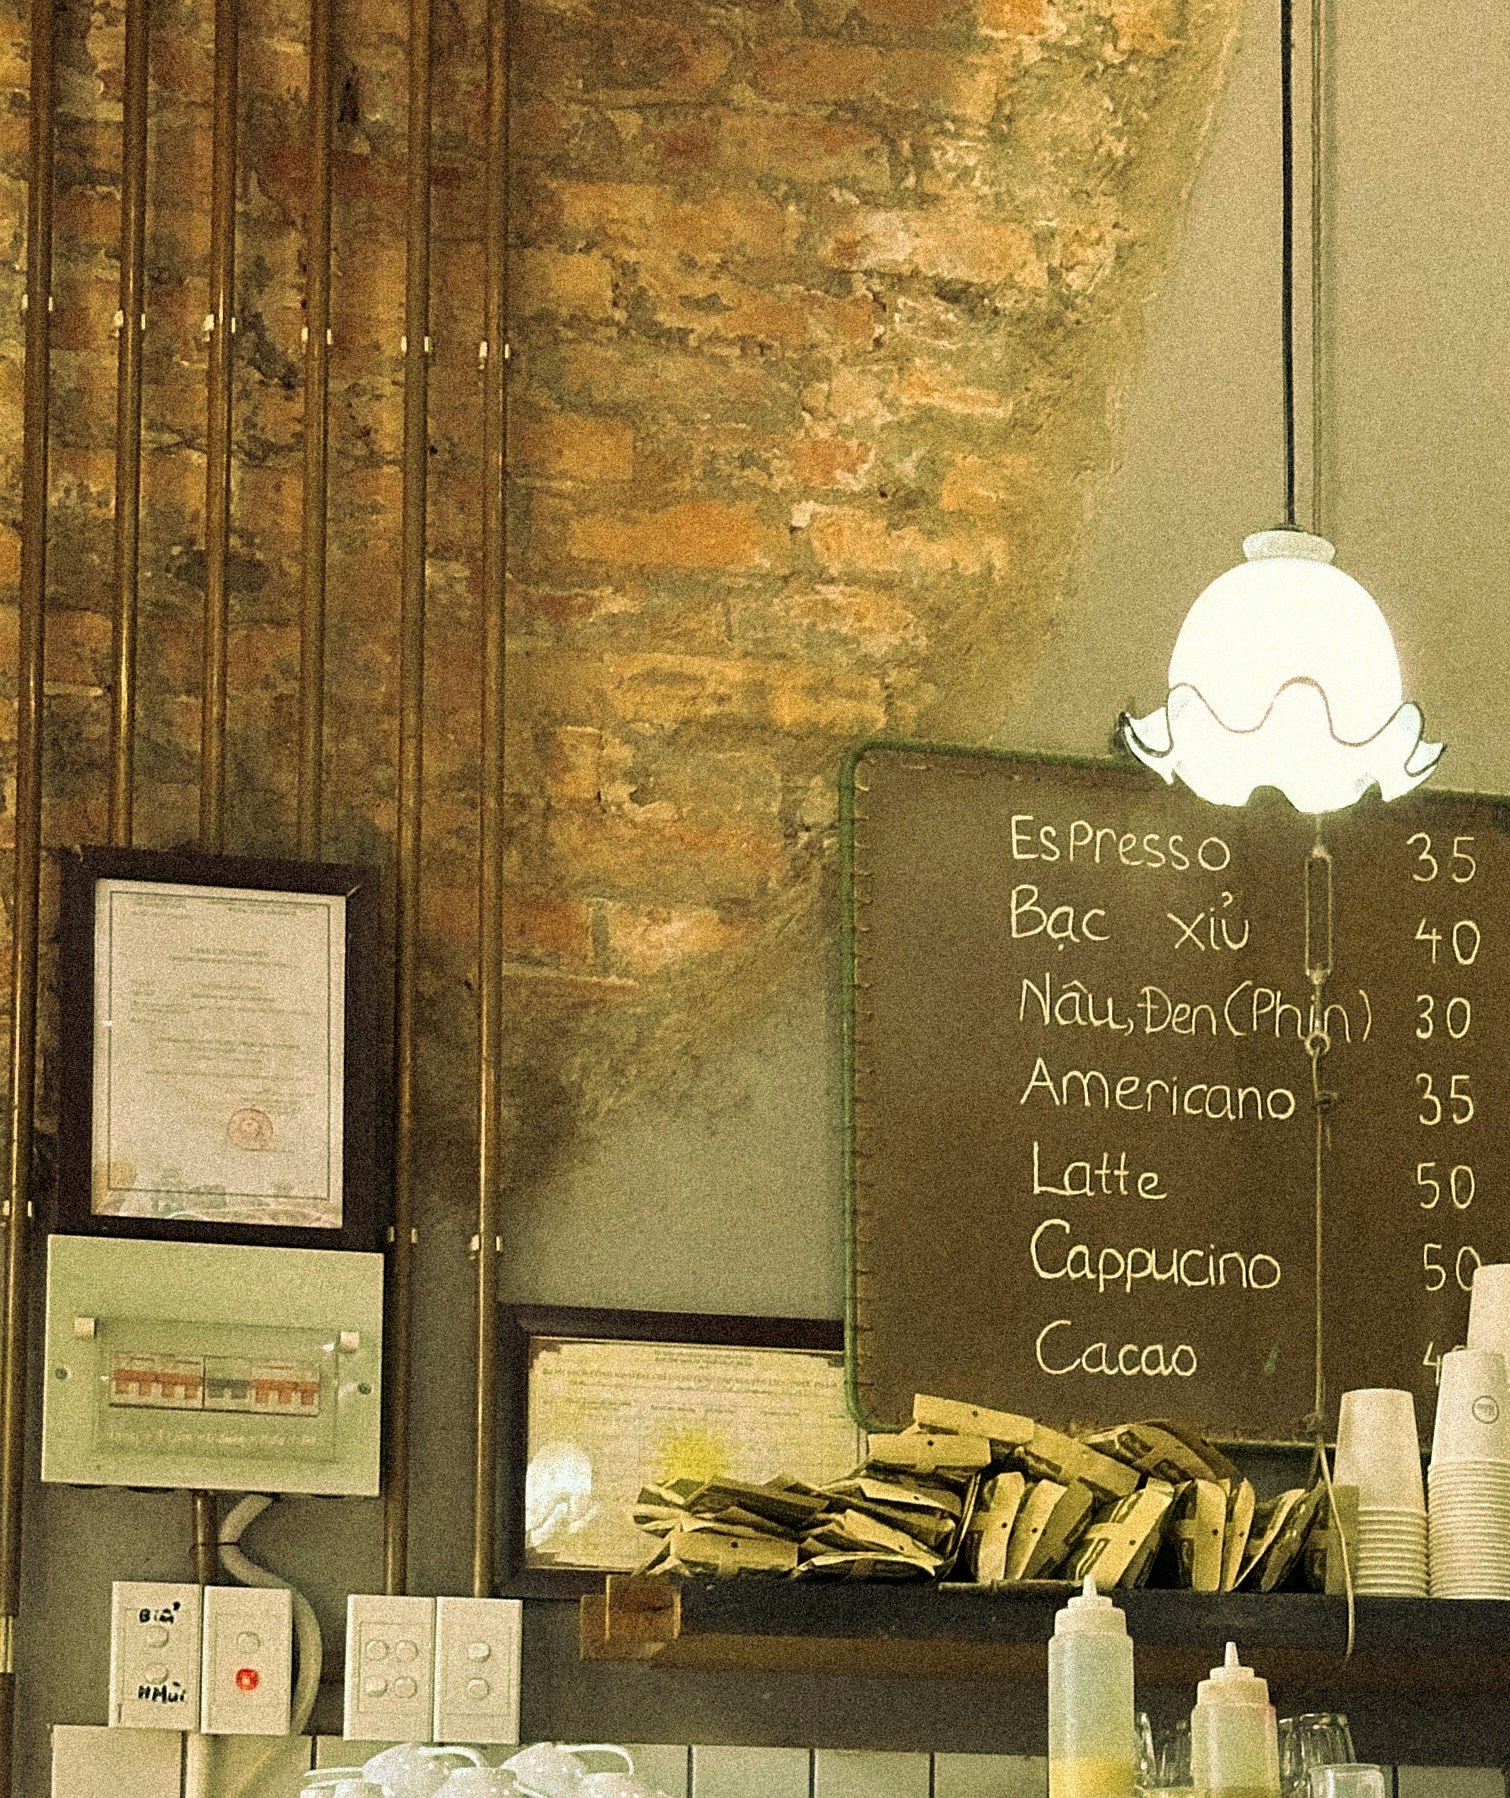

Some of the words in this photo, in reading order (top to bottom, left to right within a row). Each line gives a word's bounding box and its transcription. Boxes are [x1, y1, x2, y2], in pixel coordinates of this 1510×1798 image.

[1405, 831, 1477, 885] 35
[1009, 883, 1109, 952] Bạc
[1414, 917, 1482, 967] 40
[1414, 993, 1473, 1041] 30
[1019, 1056, 1297, 1122] Americano
[1415, 1071, 1476, 1127] 35
[1031, 1140, 1168, 1201] Latte
[1415, 1160, 1477, 1211] 50
[1028, 1217, 1283, 1294] Cappucino
[1422, 1242, 1481, 1291] 50
[1034, 1318, 1199, 1378] Cacao
[1422, 1341, 1467, 1386] 4
